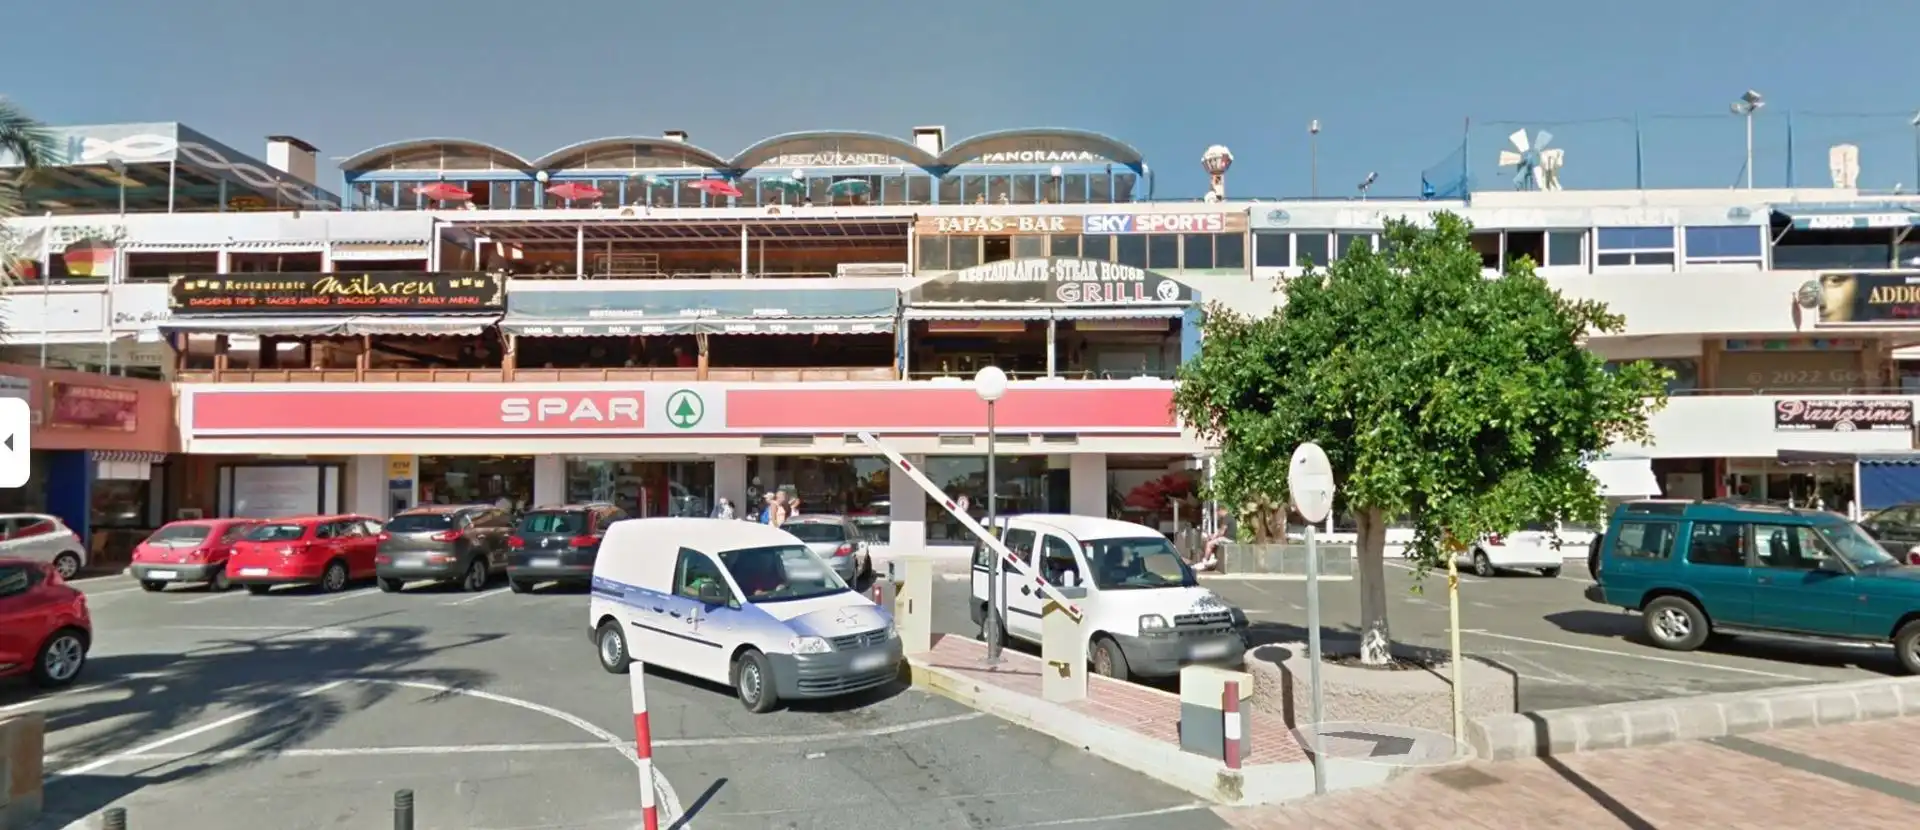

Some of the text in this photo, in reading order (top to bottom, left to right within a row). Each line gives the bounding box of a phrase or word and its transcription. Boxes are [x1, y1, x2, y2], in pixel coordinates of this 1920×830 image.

[779, 153, 887, 166] RESTAURANTE
[983, 151, 1093, 165] PANORAMA
[1087, 213, 1222, 232] SKY SPORTS
[1055, 258, 1098, 282] STEAK
[1100, 261, 1145, 281] HOUSE
[225, 273, 435, 295] Restaurante Mälaren
[1056, 282, 1153, 302] GRILL
[189, 297, 232, 306] DAGENS
[235, 297, 256, 305] TIPS
[418, 296, 446, 304] DAILY
[501, 397, 639, 422] SPAR
